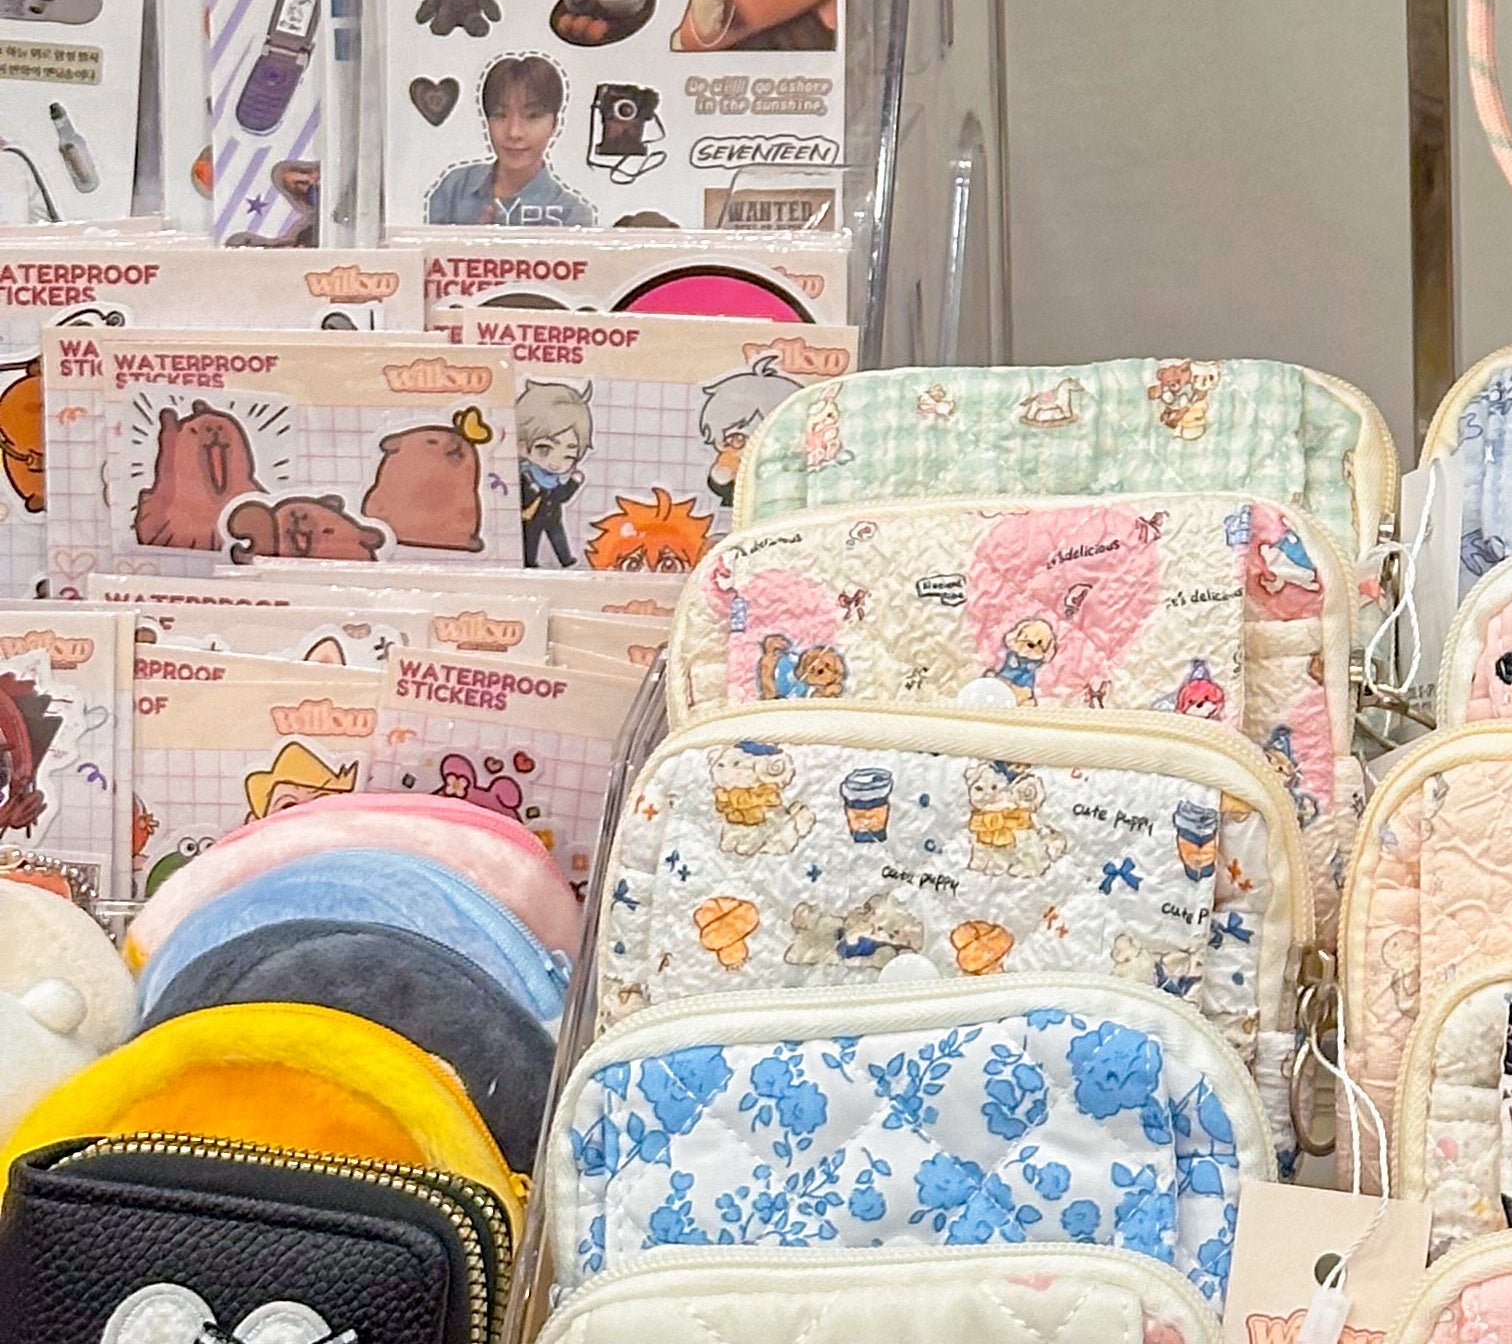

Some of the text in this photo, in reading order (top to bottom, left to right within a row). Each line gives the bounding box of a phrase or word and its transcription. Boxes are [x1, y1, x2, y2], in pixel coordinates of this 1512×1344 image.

[698, 143, 832, 162] SEVENTEEN
[728, 201, 813, 222] WANTED
[0, 264, 160, 285] ATERPROOF
[425, 258, 588, 281] ATERPROOF
[477, 322, 640, 347] WATERPROOF
[114, 354, 280, 373] WATERPROOF
[513, 344, 584, 364] CKERS
[1065, 539, 1121, 561] delicious
[399, 659, 567, 699] WATERPROOF
[396, 678, 508, 711] STICKERS
[1073, 803, 1153, 836] cute puppy
[919, 872, 959, 896] puppy
[1161, 901, 1194, 925] cute
